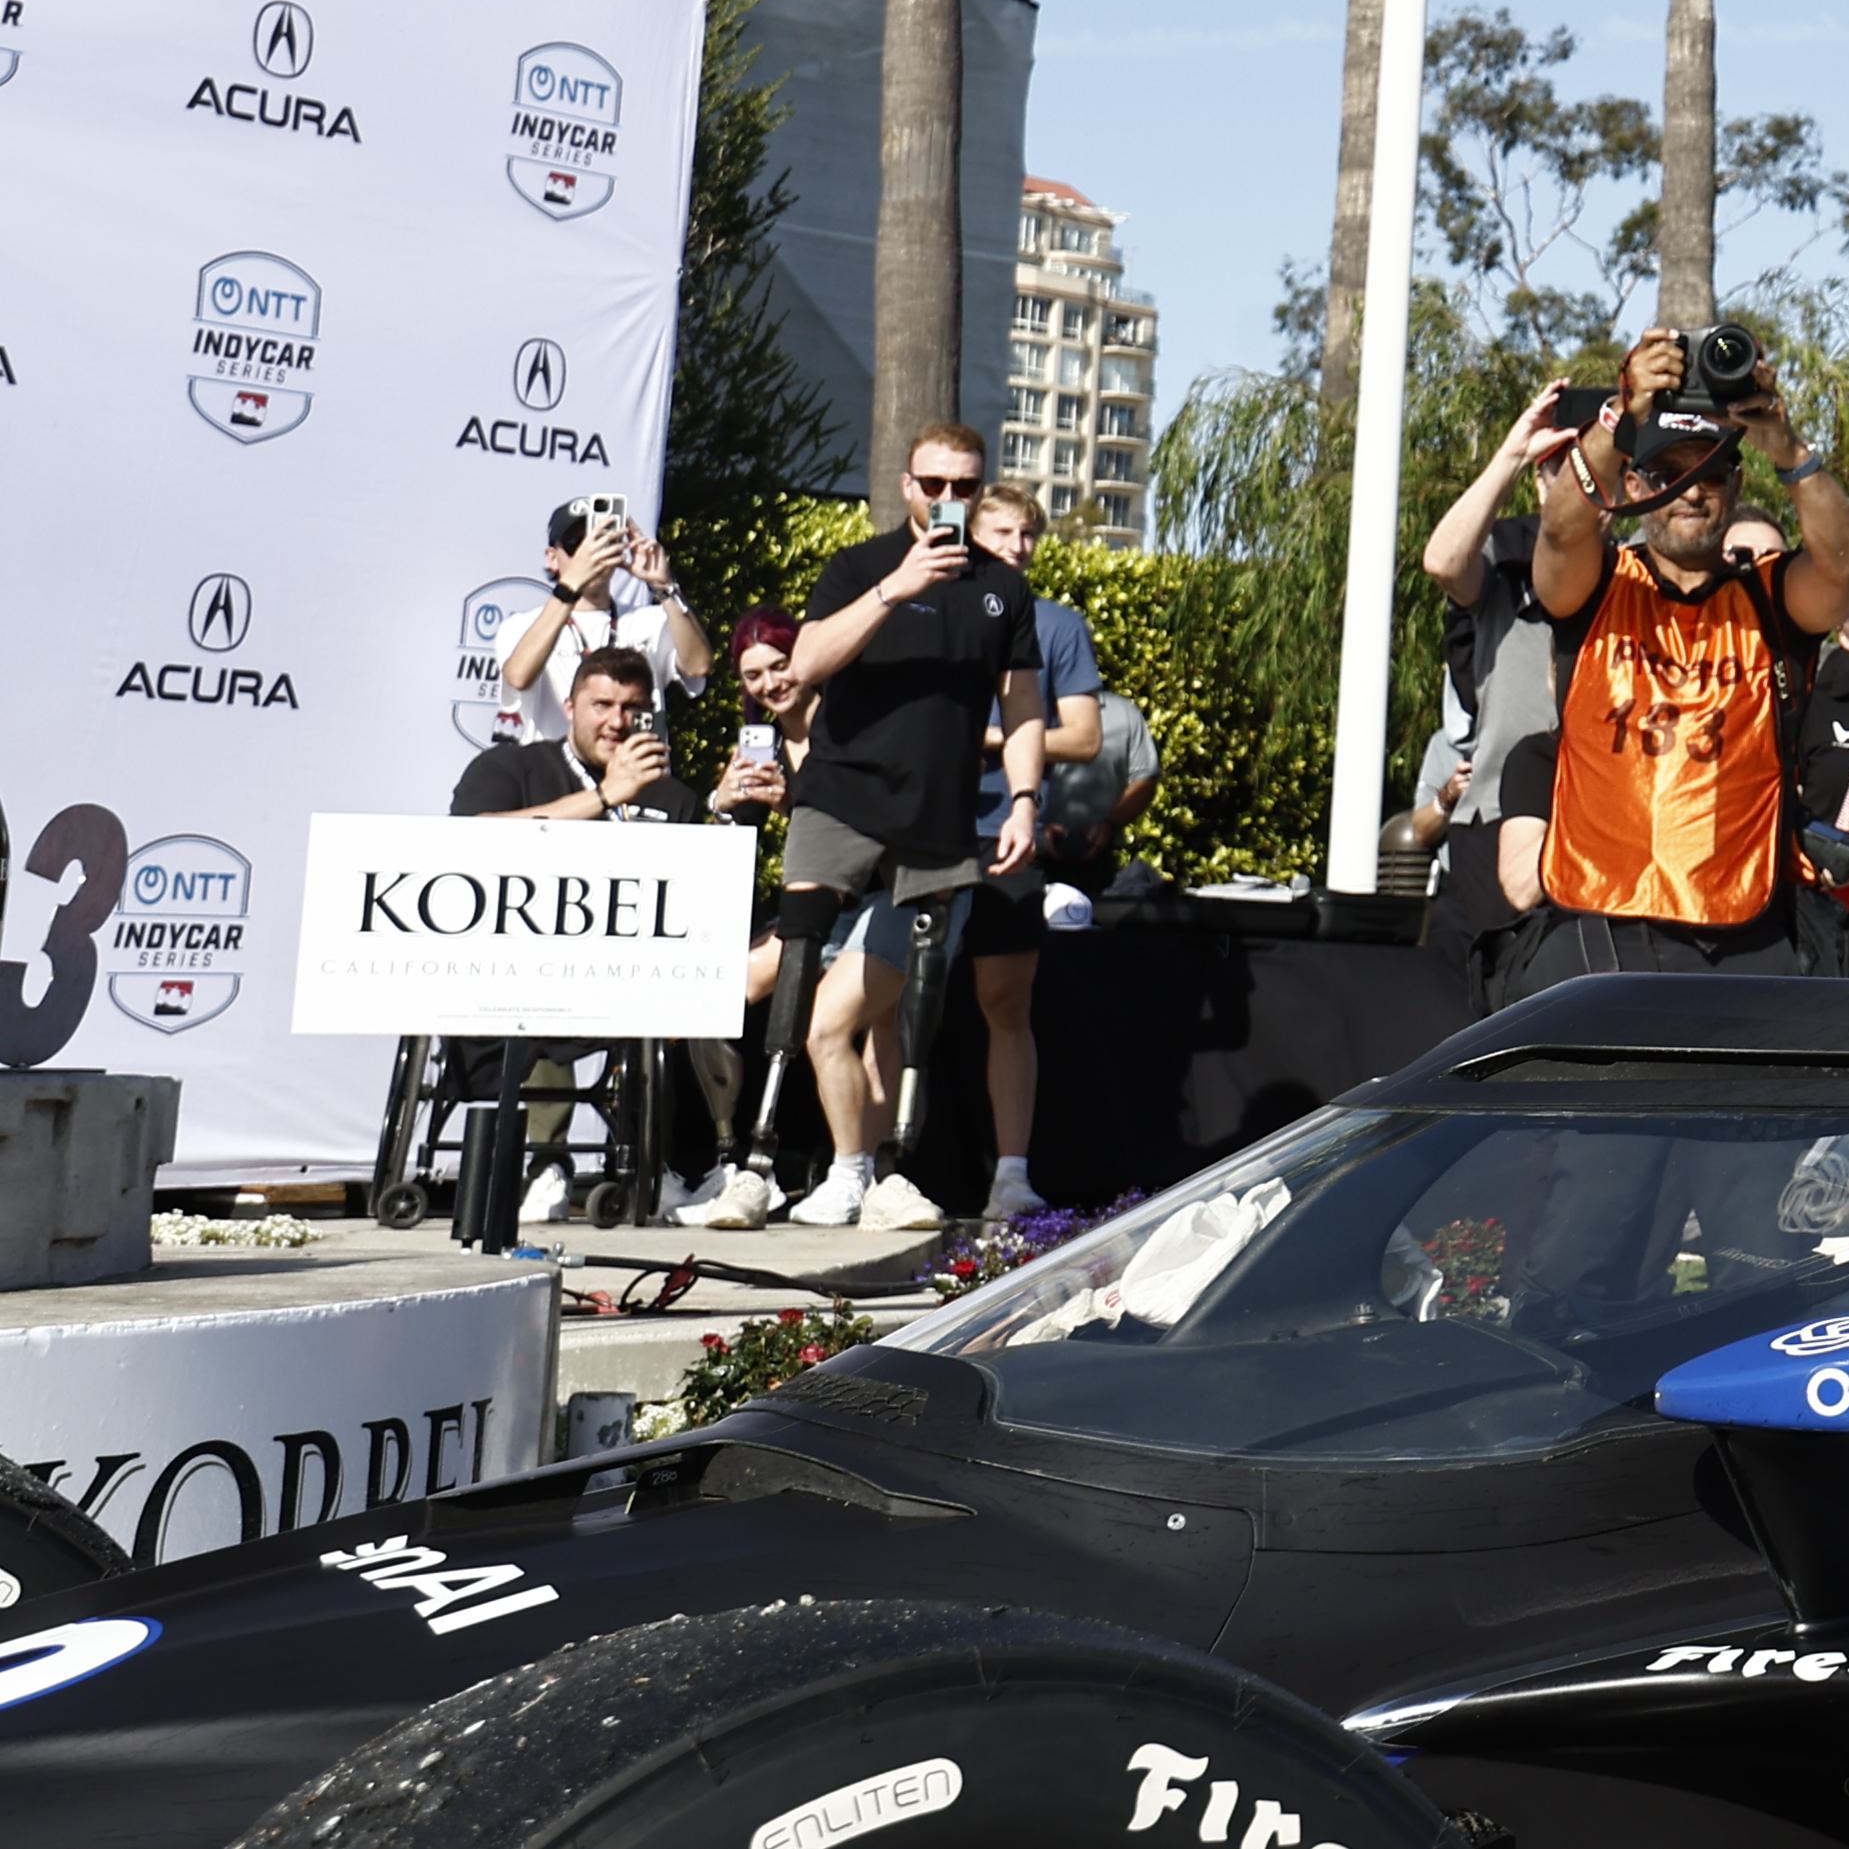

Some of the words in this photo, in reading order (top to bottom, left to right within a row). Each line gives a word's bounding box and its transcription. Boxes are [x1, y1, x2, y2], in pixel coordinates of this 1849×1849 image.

[186, 77, 362, 144] ACURA
[558, 75, 612, 111] NTT
[511, 112, 618, 156] INDYCAR
[531, 140, 593, 167] SERIES
[248, 287, 308, 324] NTT
[192, 327, 316, 371] INDYCAR
[215, 358, 287, 385] SERIES
[455, 416, 610, 467] ACURA
[1611, 639, 1743, 690] PHOTO
[115, 661, 300, 710] ACURA
[1605, 698, 1728, 765] 183
[172, 871, 237, 904] NTT
[357, 870, 692, 940] KORBEL
[113, 920, 244, 951] INDYCAR
[138, 951, 214, 968] SERIES
[320, 958, 520, 978] CALIFORNIA
[538, 960, 729, 982] CHAMPAGNE
